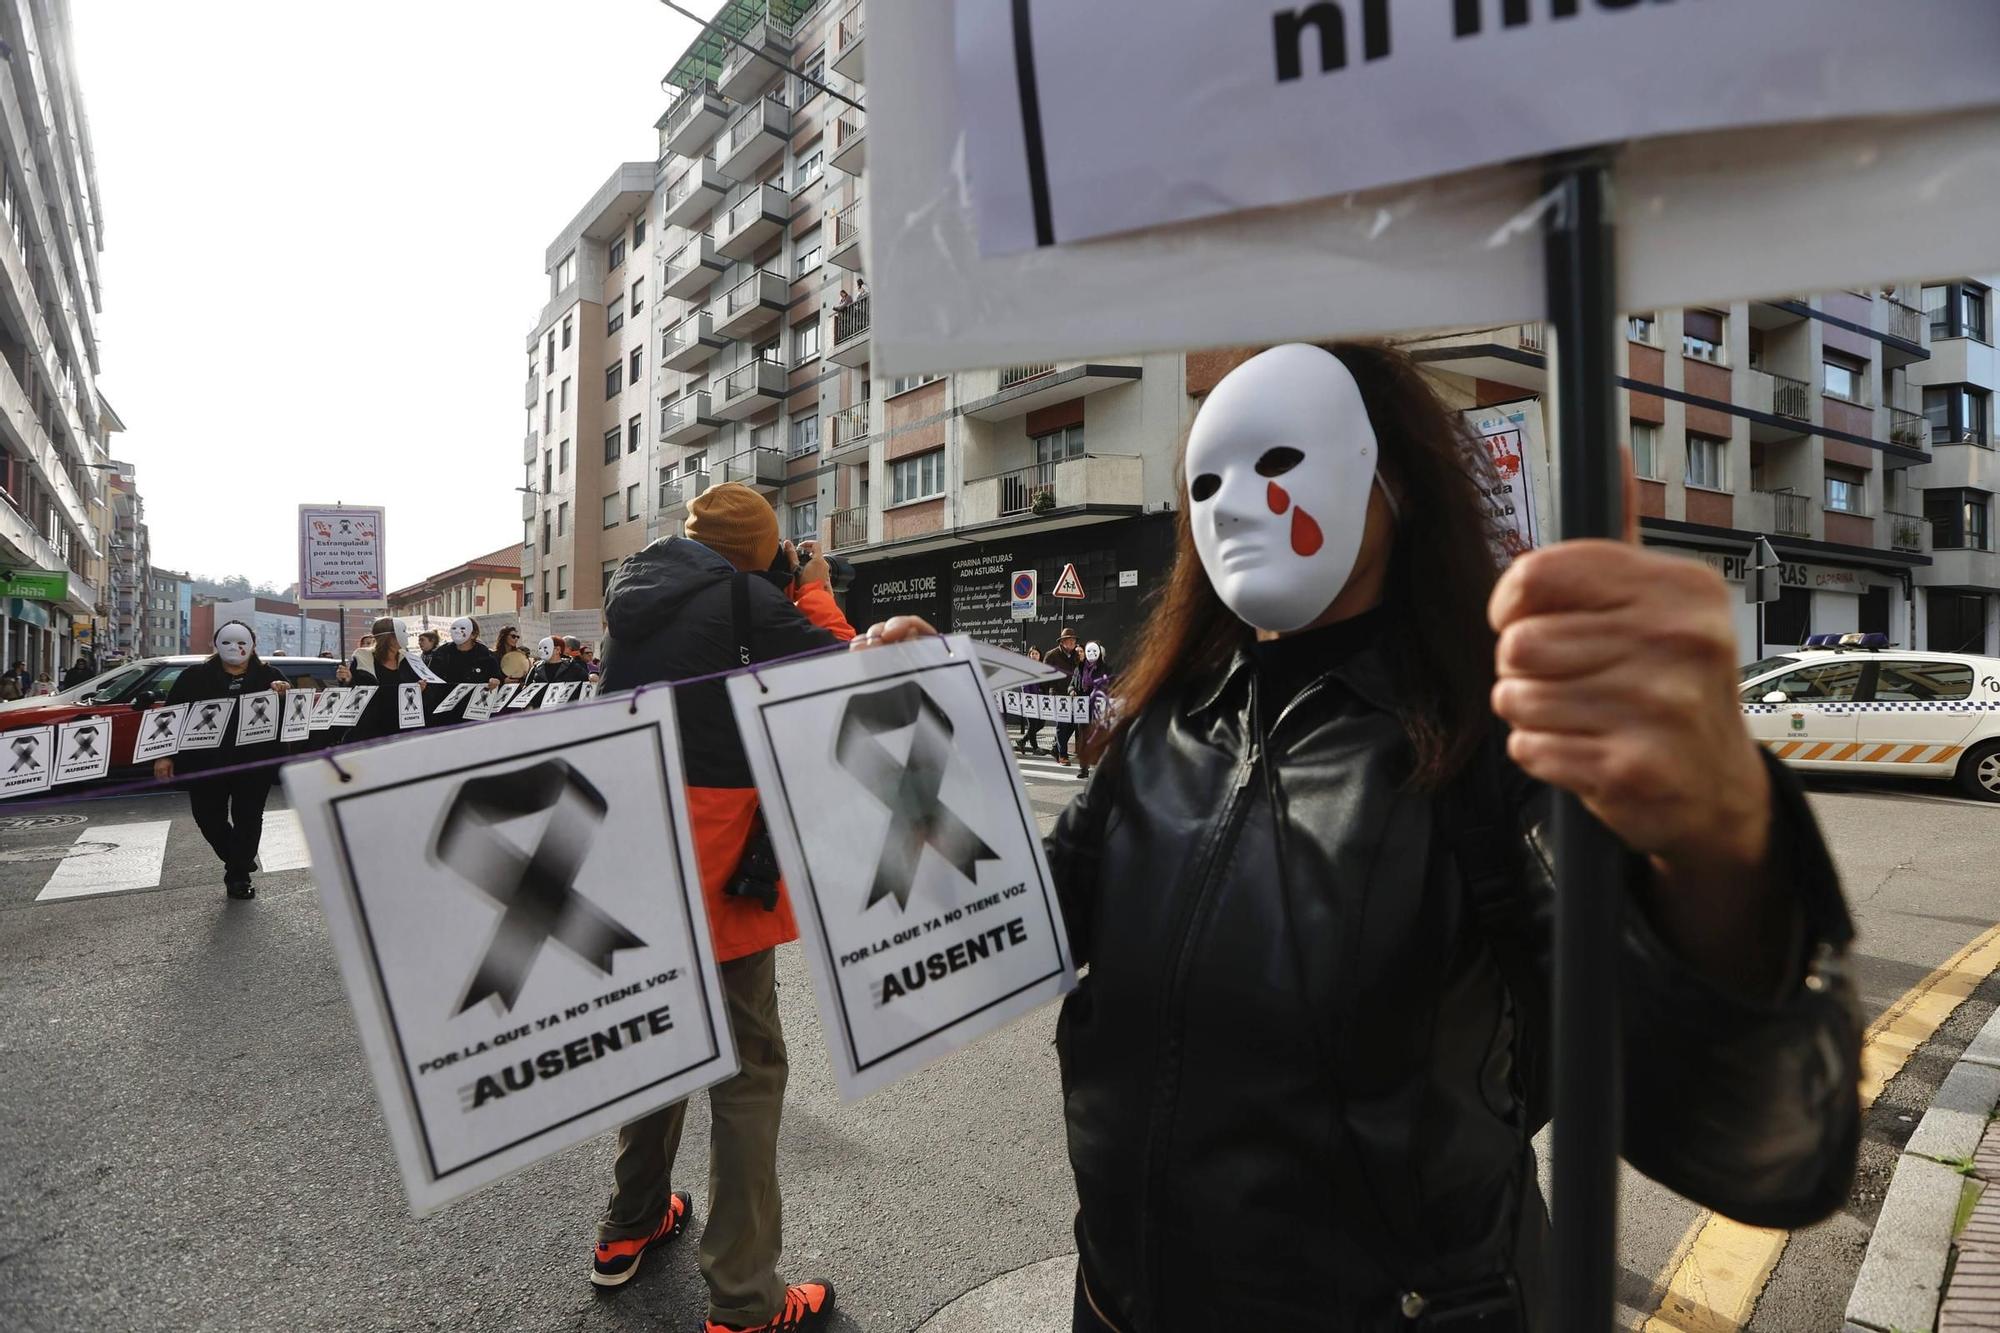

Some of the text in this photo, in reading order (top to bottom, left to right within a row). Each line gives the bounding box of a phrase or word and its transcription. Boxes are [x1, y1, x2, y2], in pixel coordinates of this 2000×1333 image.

[340, 549, 355, 557] hijo
[952, 553, 1013, 570] CAPARINA PINTURAS
[960, 564, 1004, 578] ADN ASTURIAS
[1723, 556, 1808, 586] PIRAS
[872, 576, 937, 596] CAPAROL STORE
[245, 728, 271, 737] AUSENTE
[144, 742, 173, 752] AUSENTE
[64, 763, 100, 774] AUSENTE
[5, 776, 42, 788] AUSENTE
[840, 882, 1027, 968] POR LA QUE YA NO TIENE VOZ
[881, 916, 1028, 1006] AUSENTE
[419, 968, 680, 1075] POR LA QUE YA NO TIENE VOZ
[471, 1005, 674, 1109] AUSENTE
